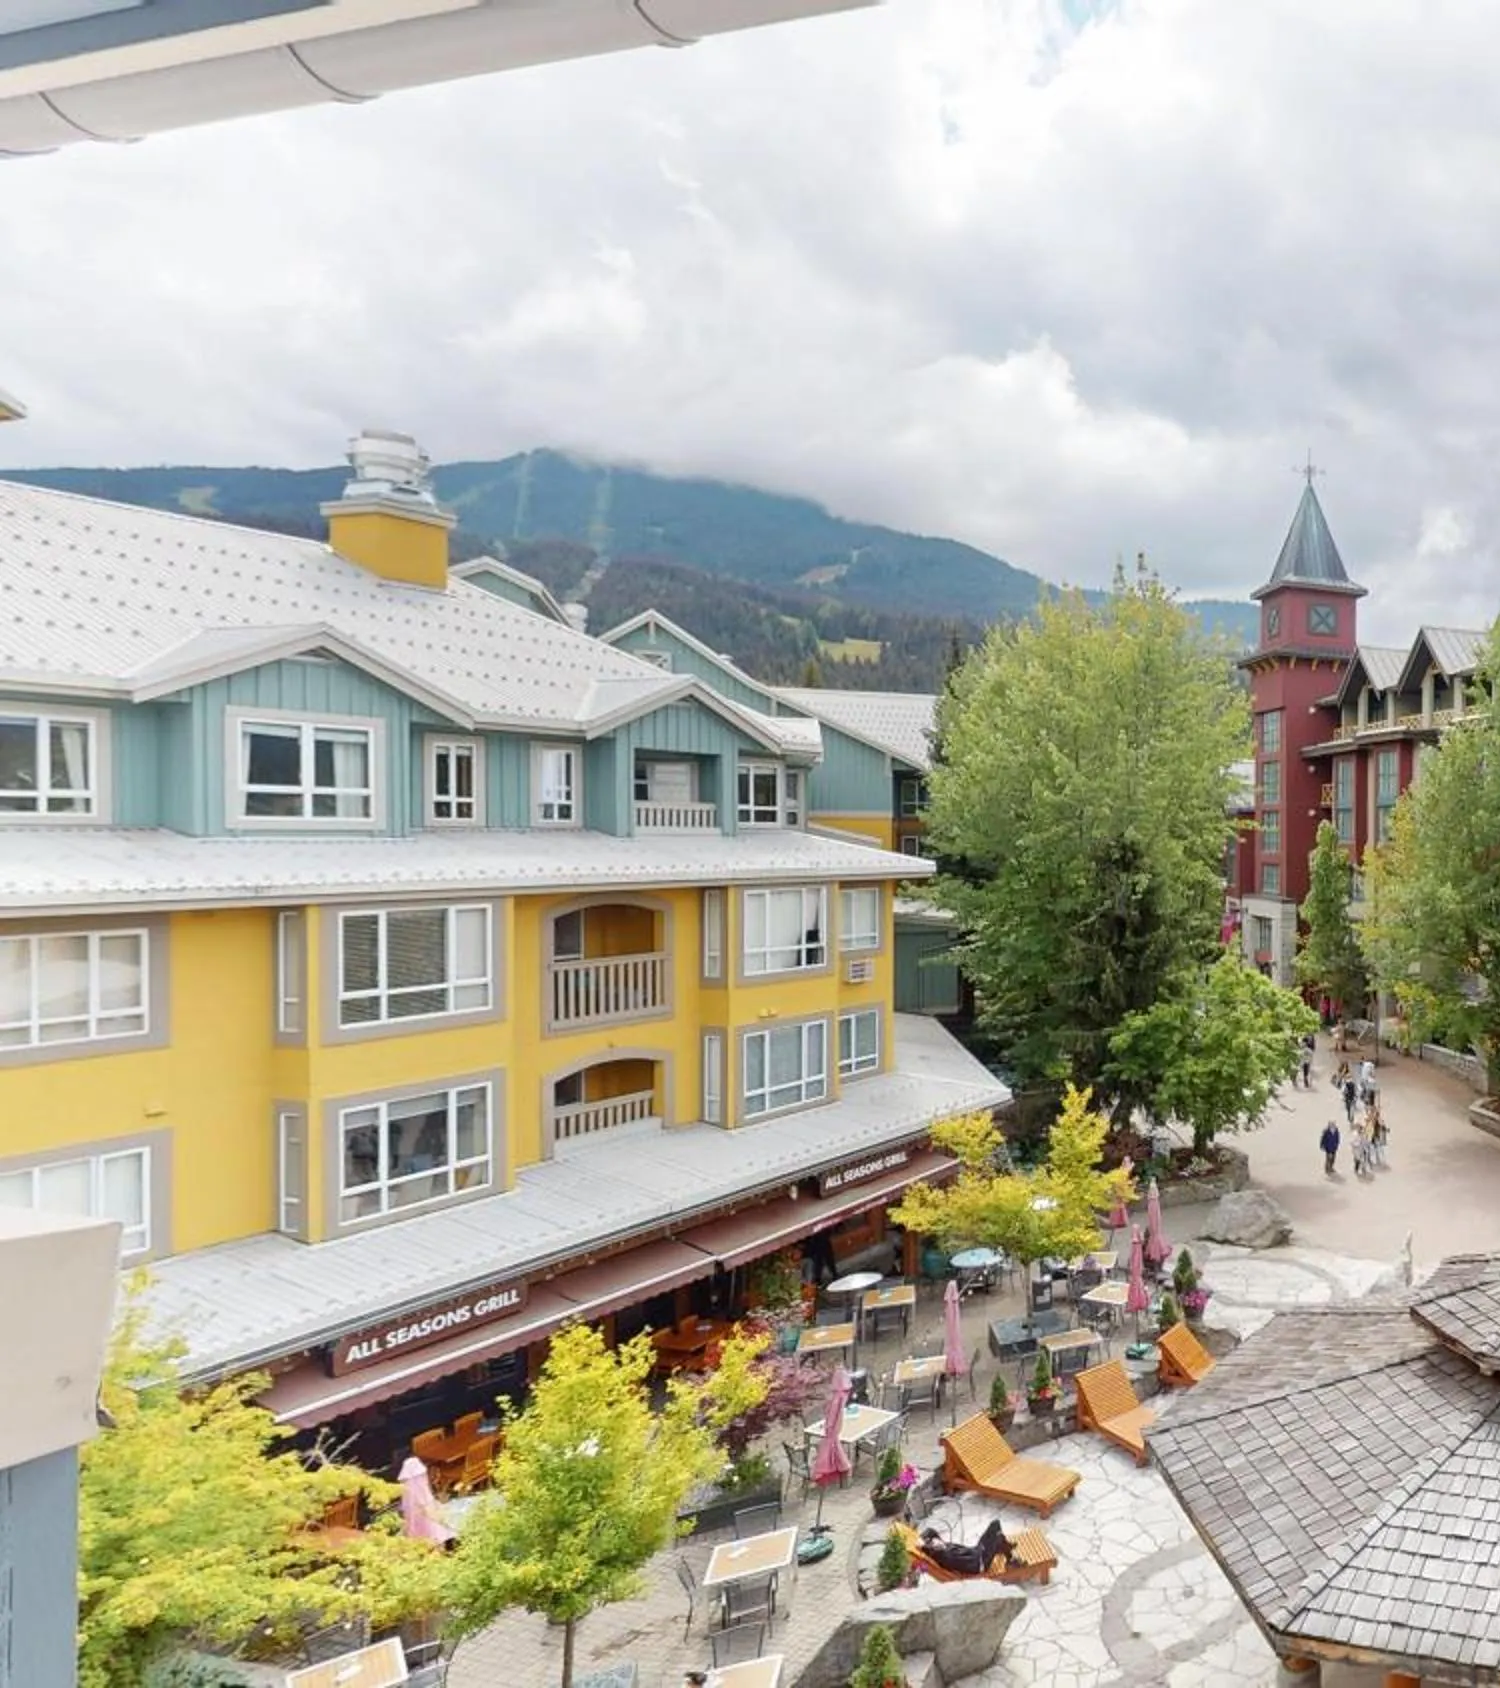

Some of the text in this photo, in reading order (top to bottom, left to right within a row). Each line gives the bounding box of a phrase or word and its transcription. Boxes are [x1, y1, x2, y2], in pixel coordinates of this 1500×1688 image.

[825, 1151, 907, 1189] ALL SEASONS GRILL
[345, 1289, 521, 1363] ALL SEASONS GRILL
